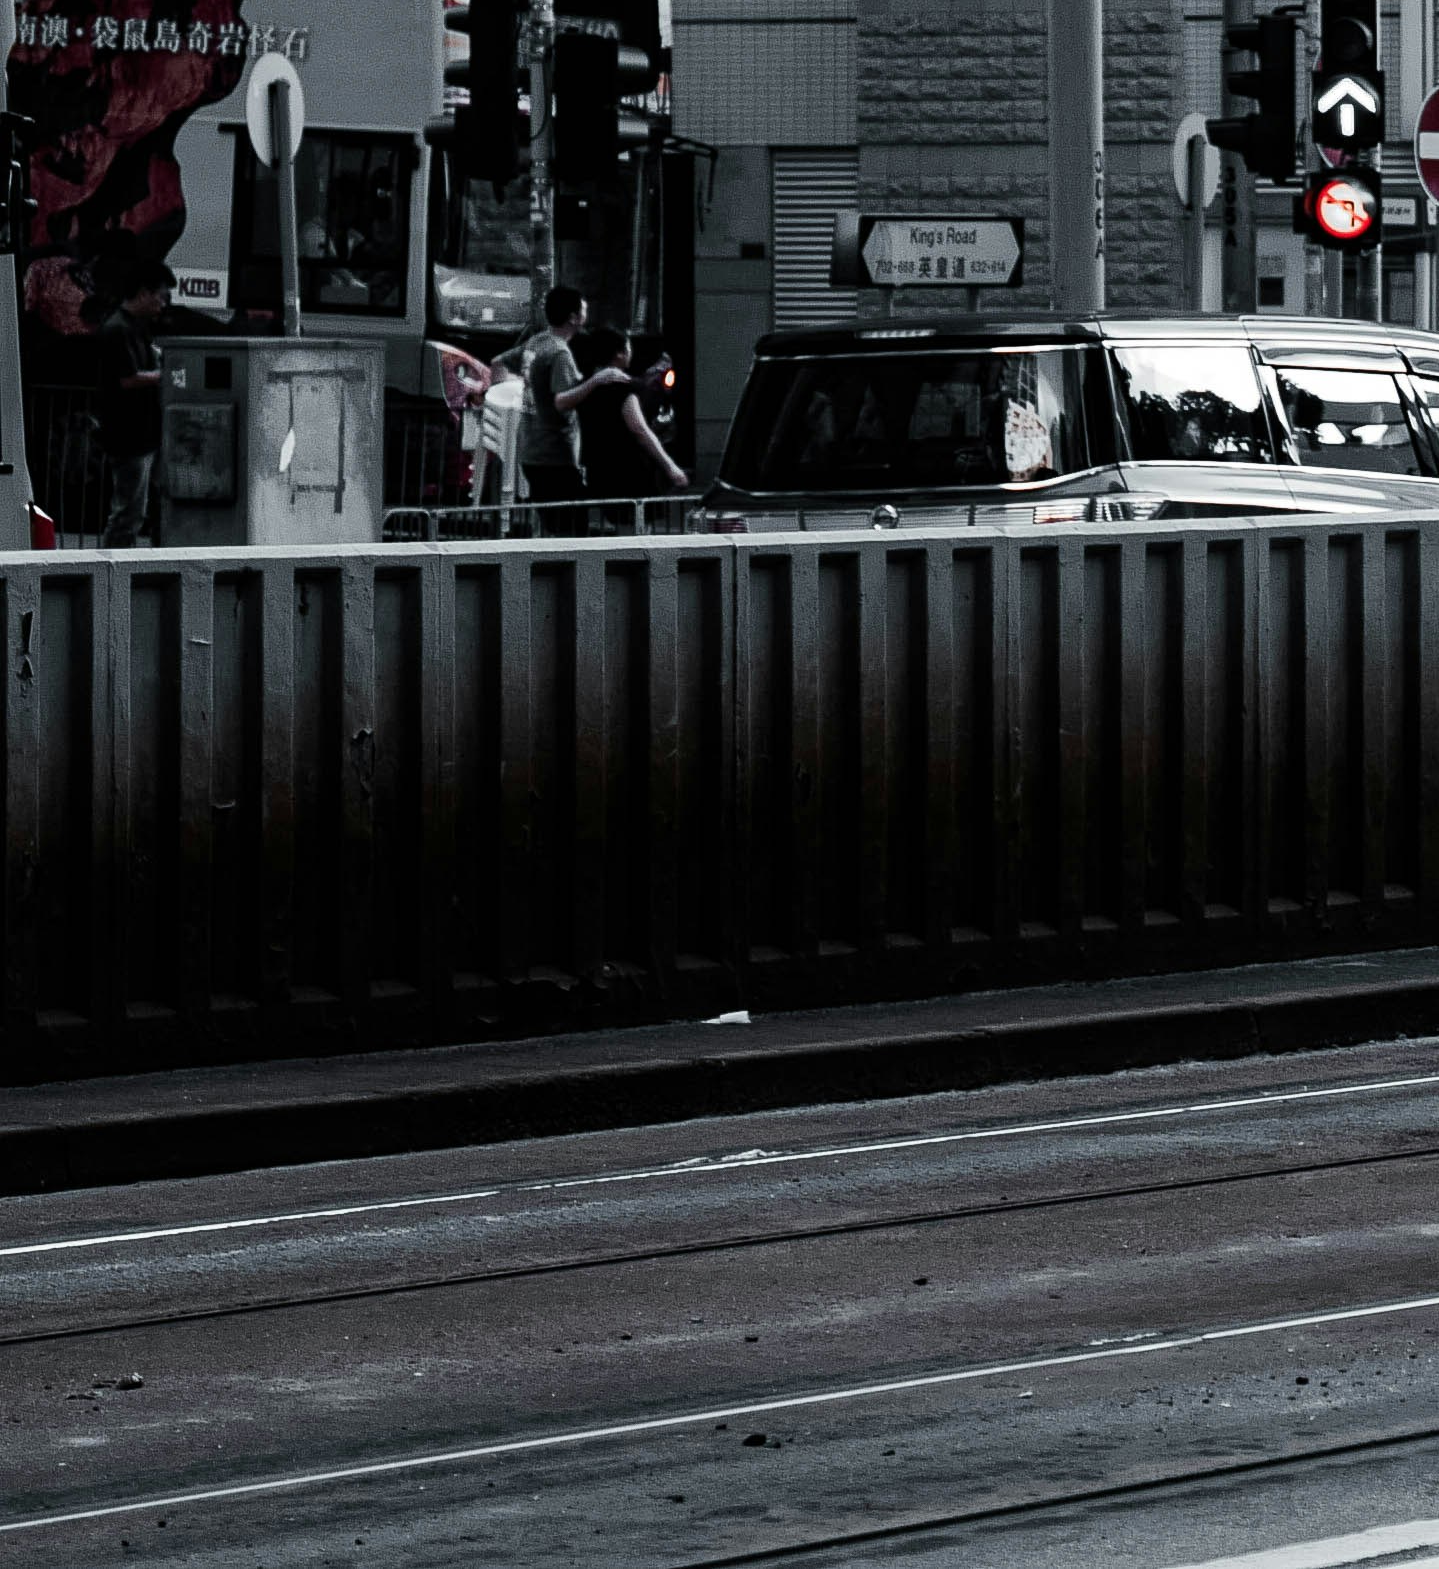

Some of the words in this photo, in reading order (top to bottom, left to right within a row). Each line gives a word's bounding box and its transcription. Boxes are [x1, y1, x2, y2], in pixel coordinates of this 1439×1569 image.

[911, 227, 944, 248] King's
[947, 227, 977, 244] Road
[918, 256, 966, 279] 英皇道
[178, 277, 220, 298] KMB
